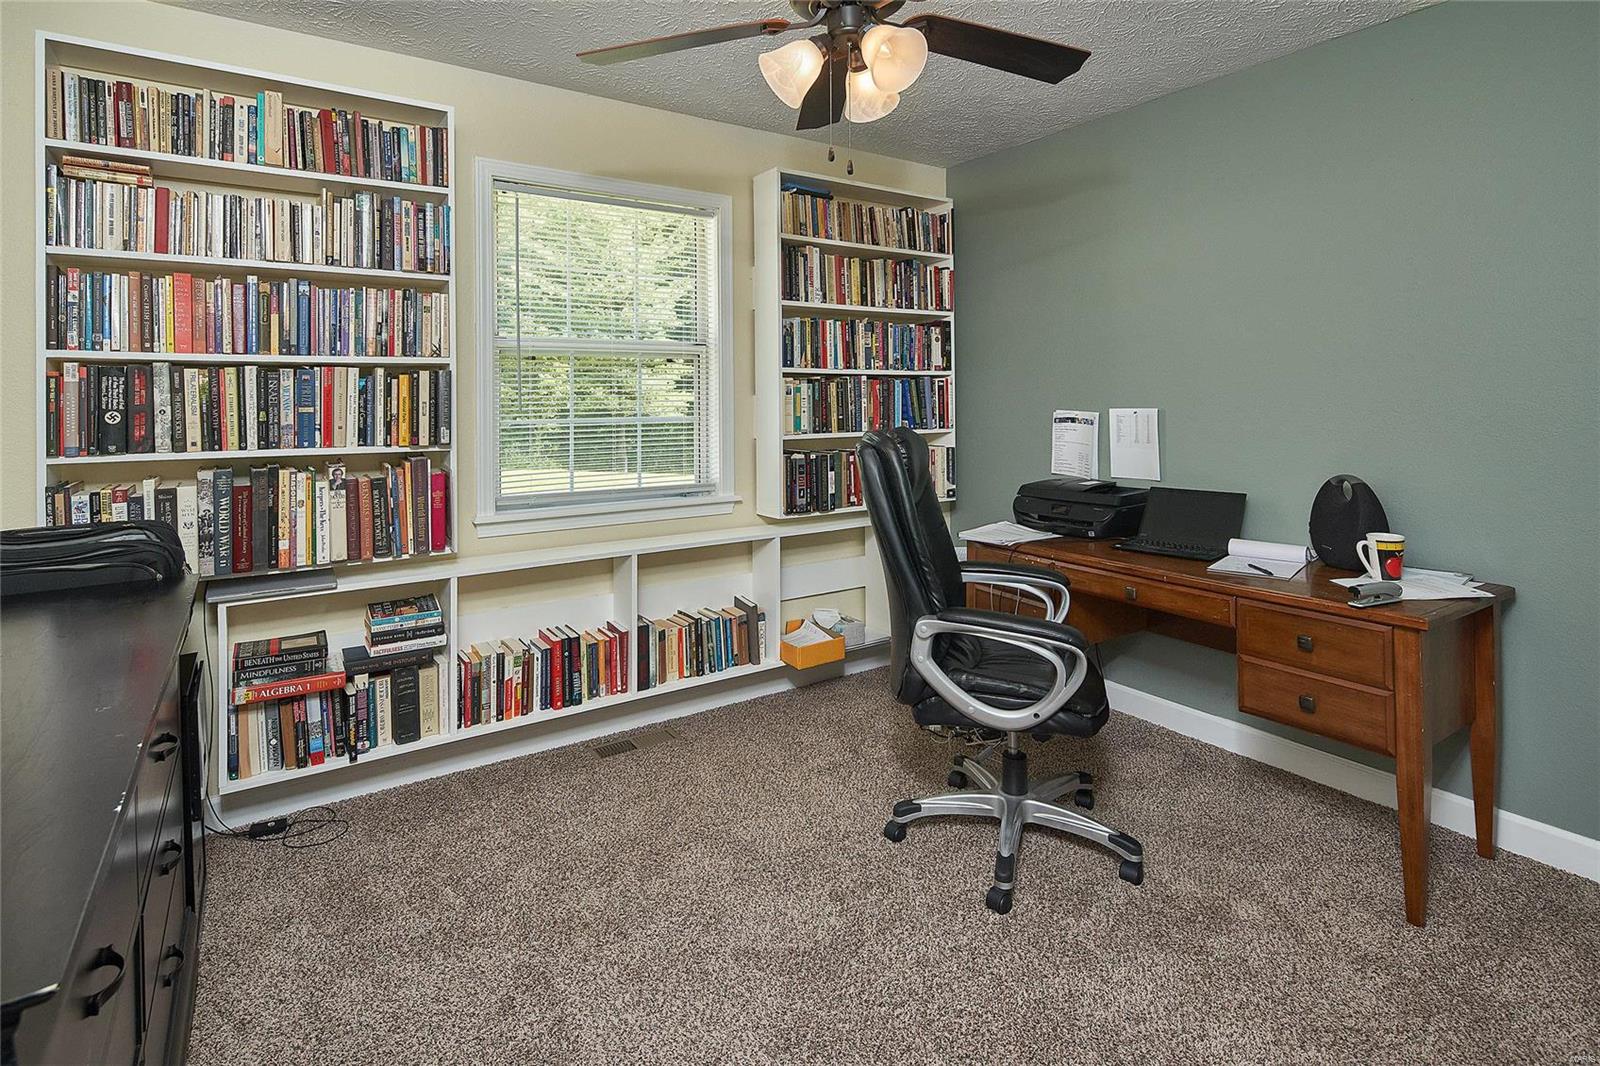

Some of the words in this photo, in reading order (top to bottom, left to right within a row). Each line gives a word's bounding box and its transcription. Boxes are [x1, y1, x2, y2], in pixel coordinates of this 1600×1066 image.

[189, 371, 198, 417] TRILATERALISM
[358, 393, 366, 408] Tropic
[361, 482, 370, 515] GENESIS
[372, 489, 381, 516] HOOVER
[417, 495, 426, 516] World
[218, 496, 231, 533] WORLD
[373, 517, 382, 541] EDGAR
[417, 517, 427, 542] History
[218, 534, 231, 558] WAR
[243, 656, 276, 667] BENEATH
[283, 653, 303, 663] UNITED
[302, 650, 320, 659] STATES
[239, 665, 297, 680] MINDFULNESS
[572, 672, 581, 694] REVIVAL
[259, 684, 305, 698] ALGEBRA
[305, 683, 311, 691] 1
